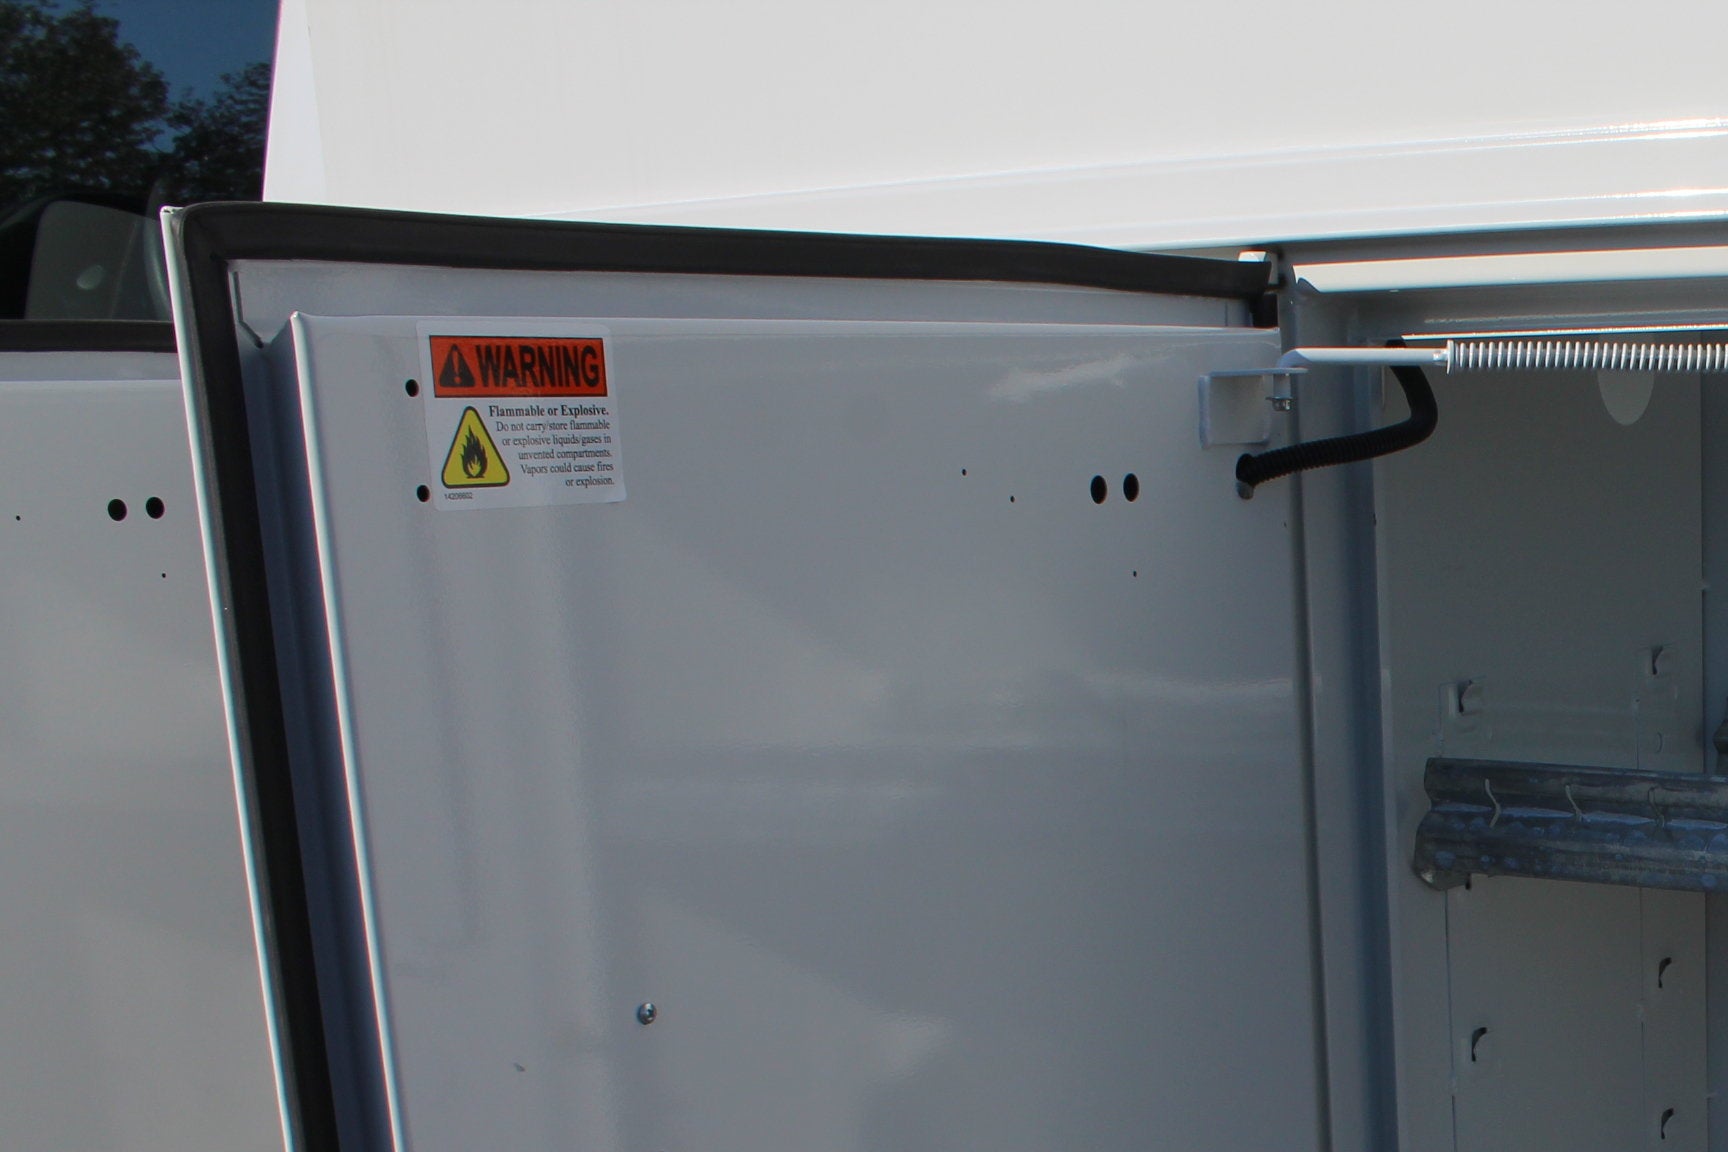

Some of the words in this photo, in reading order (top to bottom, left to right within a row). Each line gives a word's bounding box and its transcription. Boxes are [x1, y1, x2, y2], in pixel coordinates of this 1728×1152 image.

[475, 344, 599, 388] WARNING
[488, 405, 545, 417] Flammable
[548, 406, 558, 417] or
[561, 404, 609, 418] Explosive.
[496, 421, 509, 432] Do
[511, 422, 524, 431] not
[526, 420, 568, 434] carry/store
[570, 419, 611, 430] flammable
[502, 437, 511, 446] or
[513, 435, 551, 448] explosive
[552, 434, 602, 447] liquids/gases
[603, 434, 612, 444] in
[518, 449, 555, 460] unvented
[557, 449, 612, 461] compartments.
[520, 464, 548, 477] Vapors
[550, 463, 572, 473] could
[573, 464, 596, 472] cause
[597, 461, 614, 472] fires
[565, 479, 574, 487] or
[575, 477, 615, 489] explosion.
